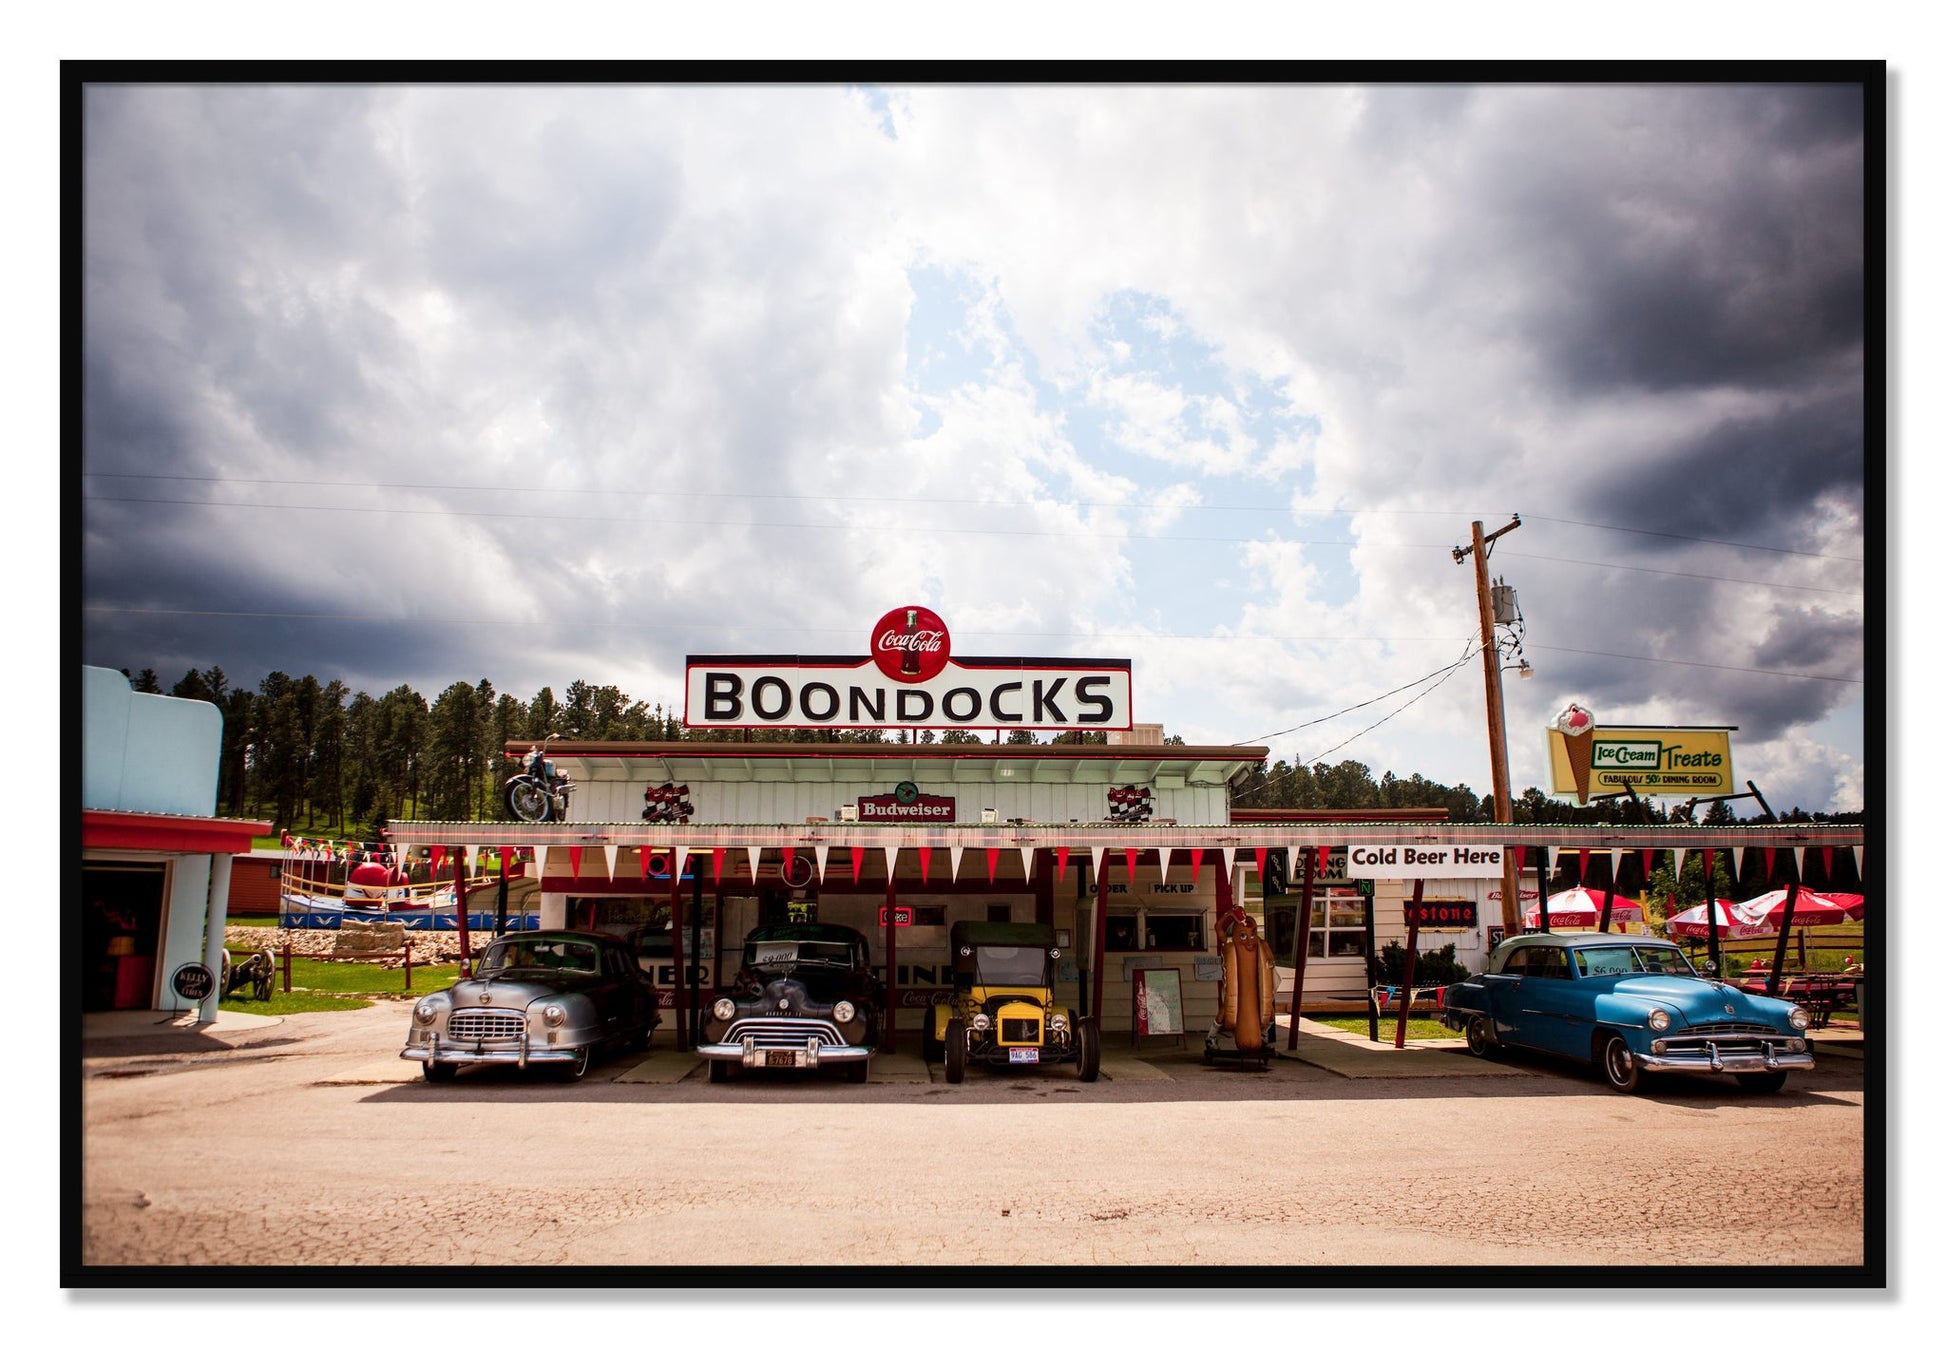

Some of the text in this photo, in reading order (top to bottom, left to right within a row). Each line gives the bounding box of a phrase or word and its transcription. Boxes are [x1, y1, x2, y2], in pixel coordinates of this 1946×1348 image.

[878, 630, 944, 652] Coca-Cola
[704, 672, 1114, 724] BOONDOCKS
[1598, 745, 1723, 769] Ice Cream Treats
[1604, 775, 1642, 783] FABULOUS
[1663, 775, 1690, 783] DINING
[863, 803, 950, 816] Budweiser
[1352, 848, 1500, 865] Cold Beer Here
[1090, 884, 1128, 894] ODER
[1154, 884, 1194, 893] PICK UP
[1550, 914, 1581, 926] Coca-Cola
